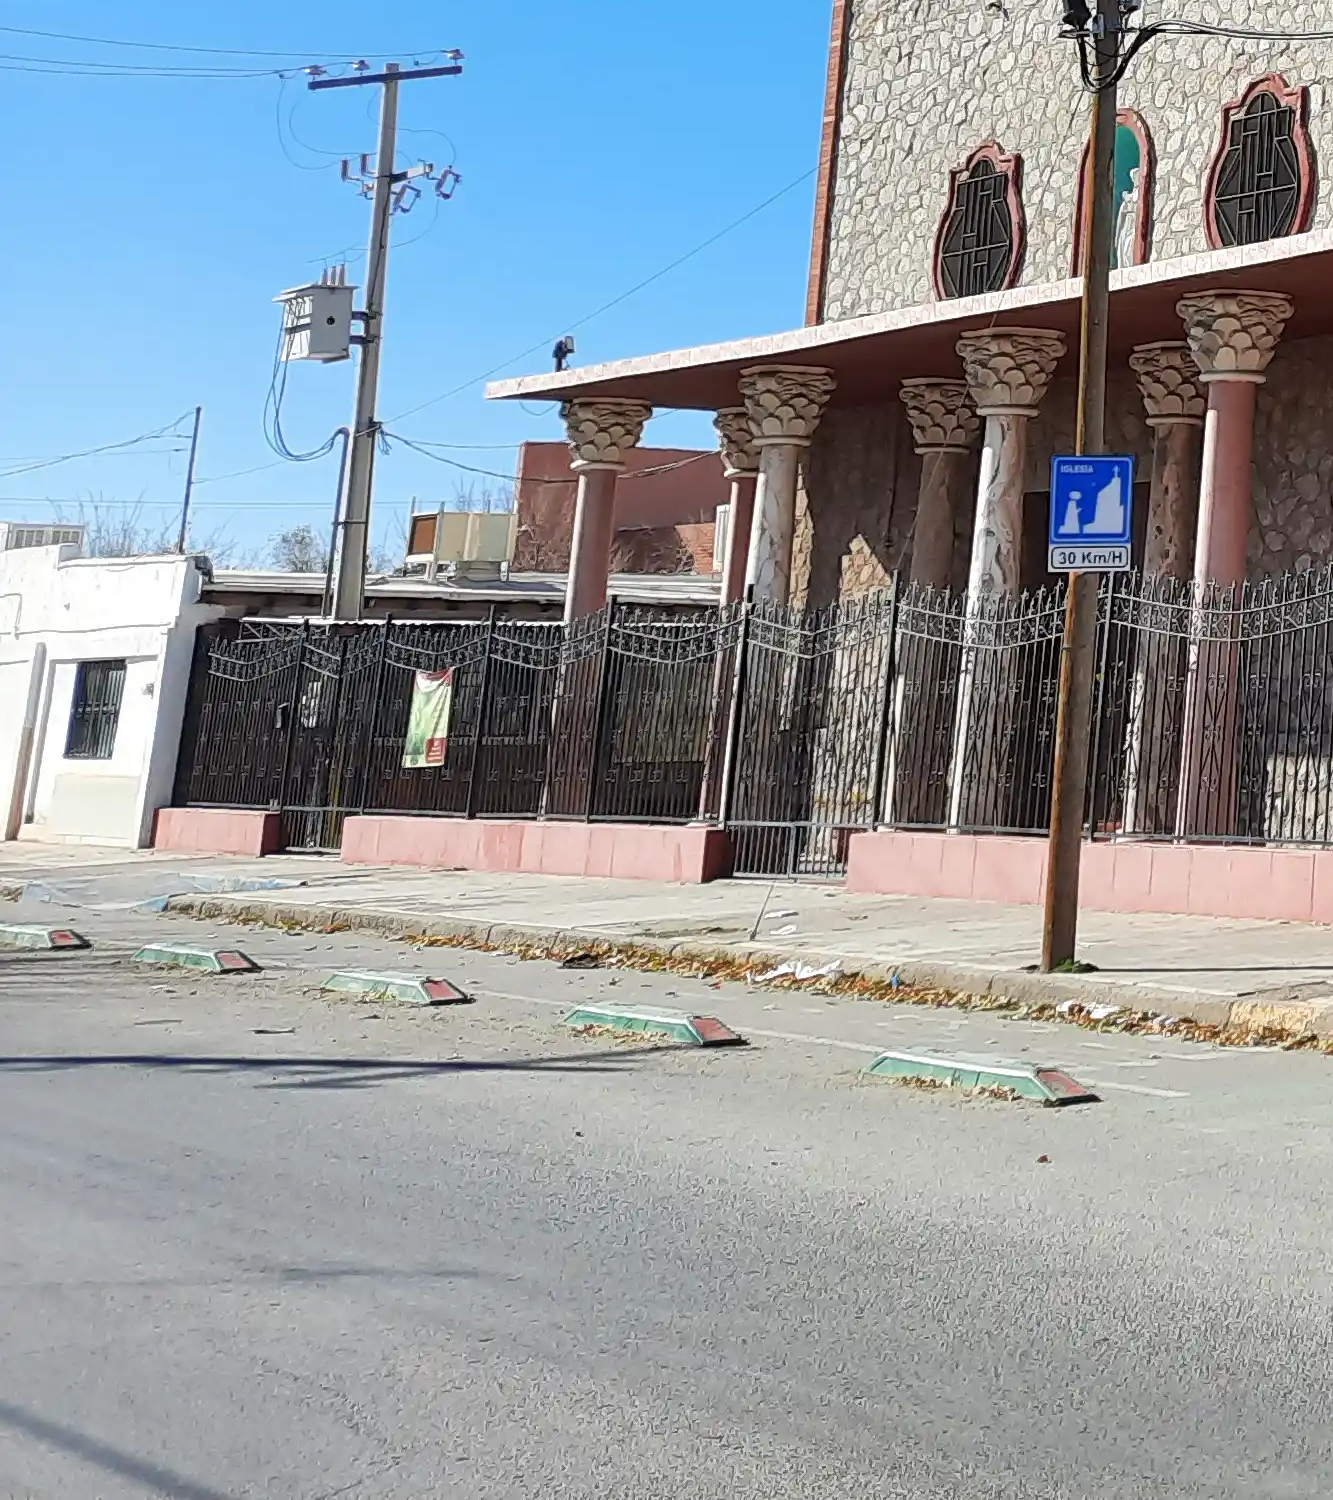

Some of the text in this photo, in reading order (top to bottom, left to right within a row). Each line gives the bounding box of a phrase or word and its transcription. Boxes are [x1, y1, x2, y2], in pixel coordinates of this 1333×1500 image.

[1060, 464, 1094, 474] IGLESIA
[1058, 551, 1122, 565] 30 Km/H
